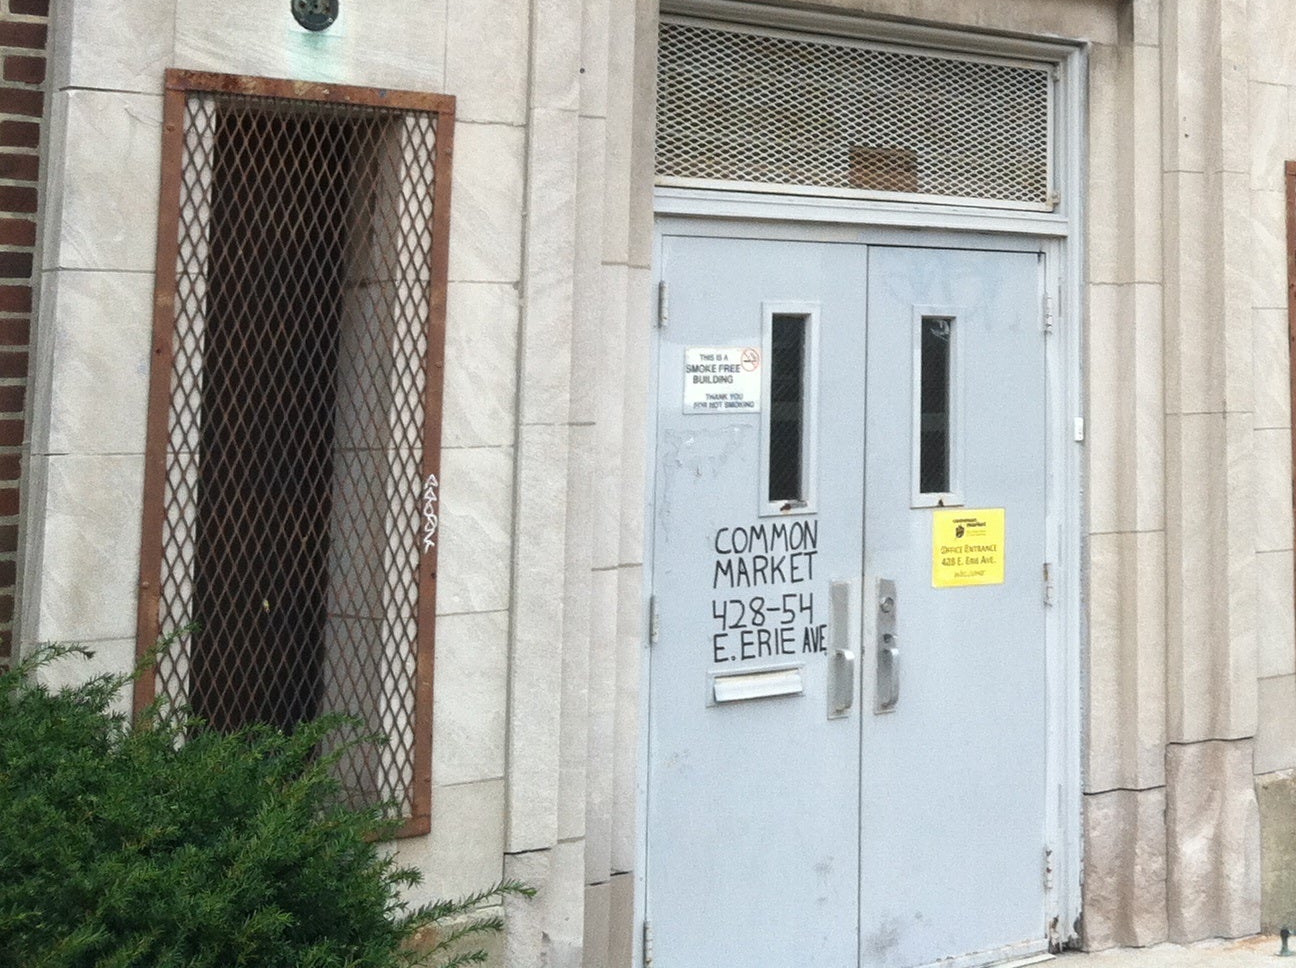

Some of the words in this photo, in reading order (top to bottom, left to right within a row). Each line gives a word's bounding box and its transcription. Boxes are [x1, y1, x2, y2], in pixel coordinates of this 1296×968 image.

[686, 364, 717, 373] SMOKE
[718, 364, 740, 373] FREE
[693, 375, 733, 384] BUILDING
[715, 519, 818, 554] COMMON
[713, 551, 818, 589] MARKET
[712, 593, 813, 631] 428-54
[713, 633, 736, 663] E.
[741, 627, 795, 660] ERIE
